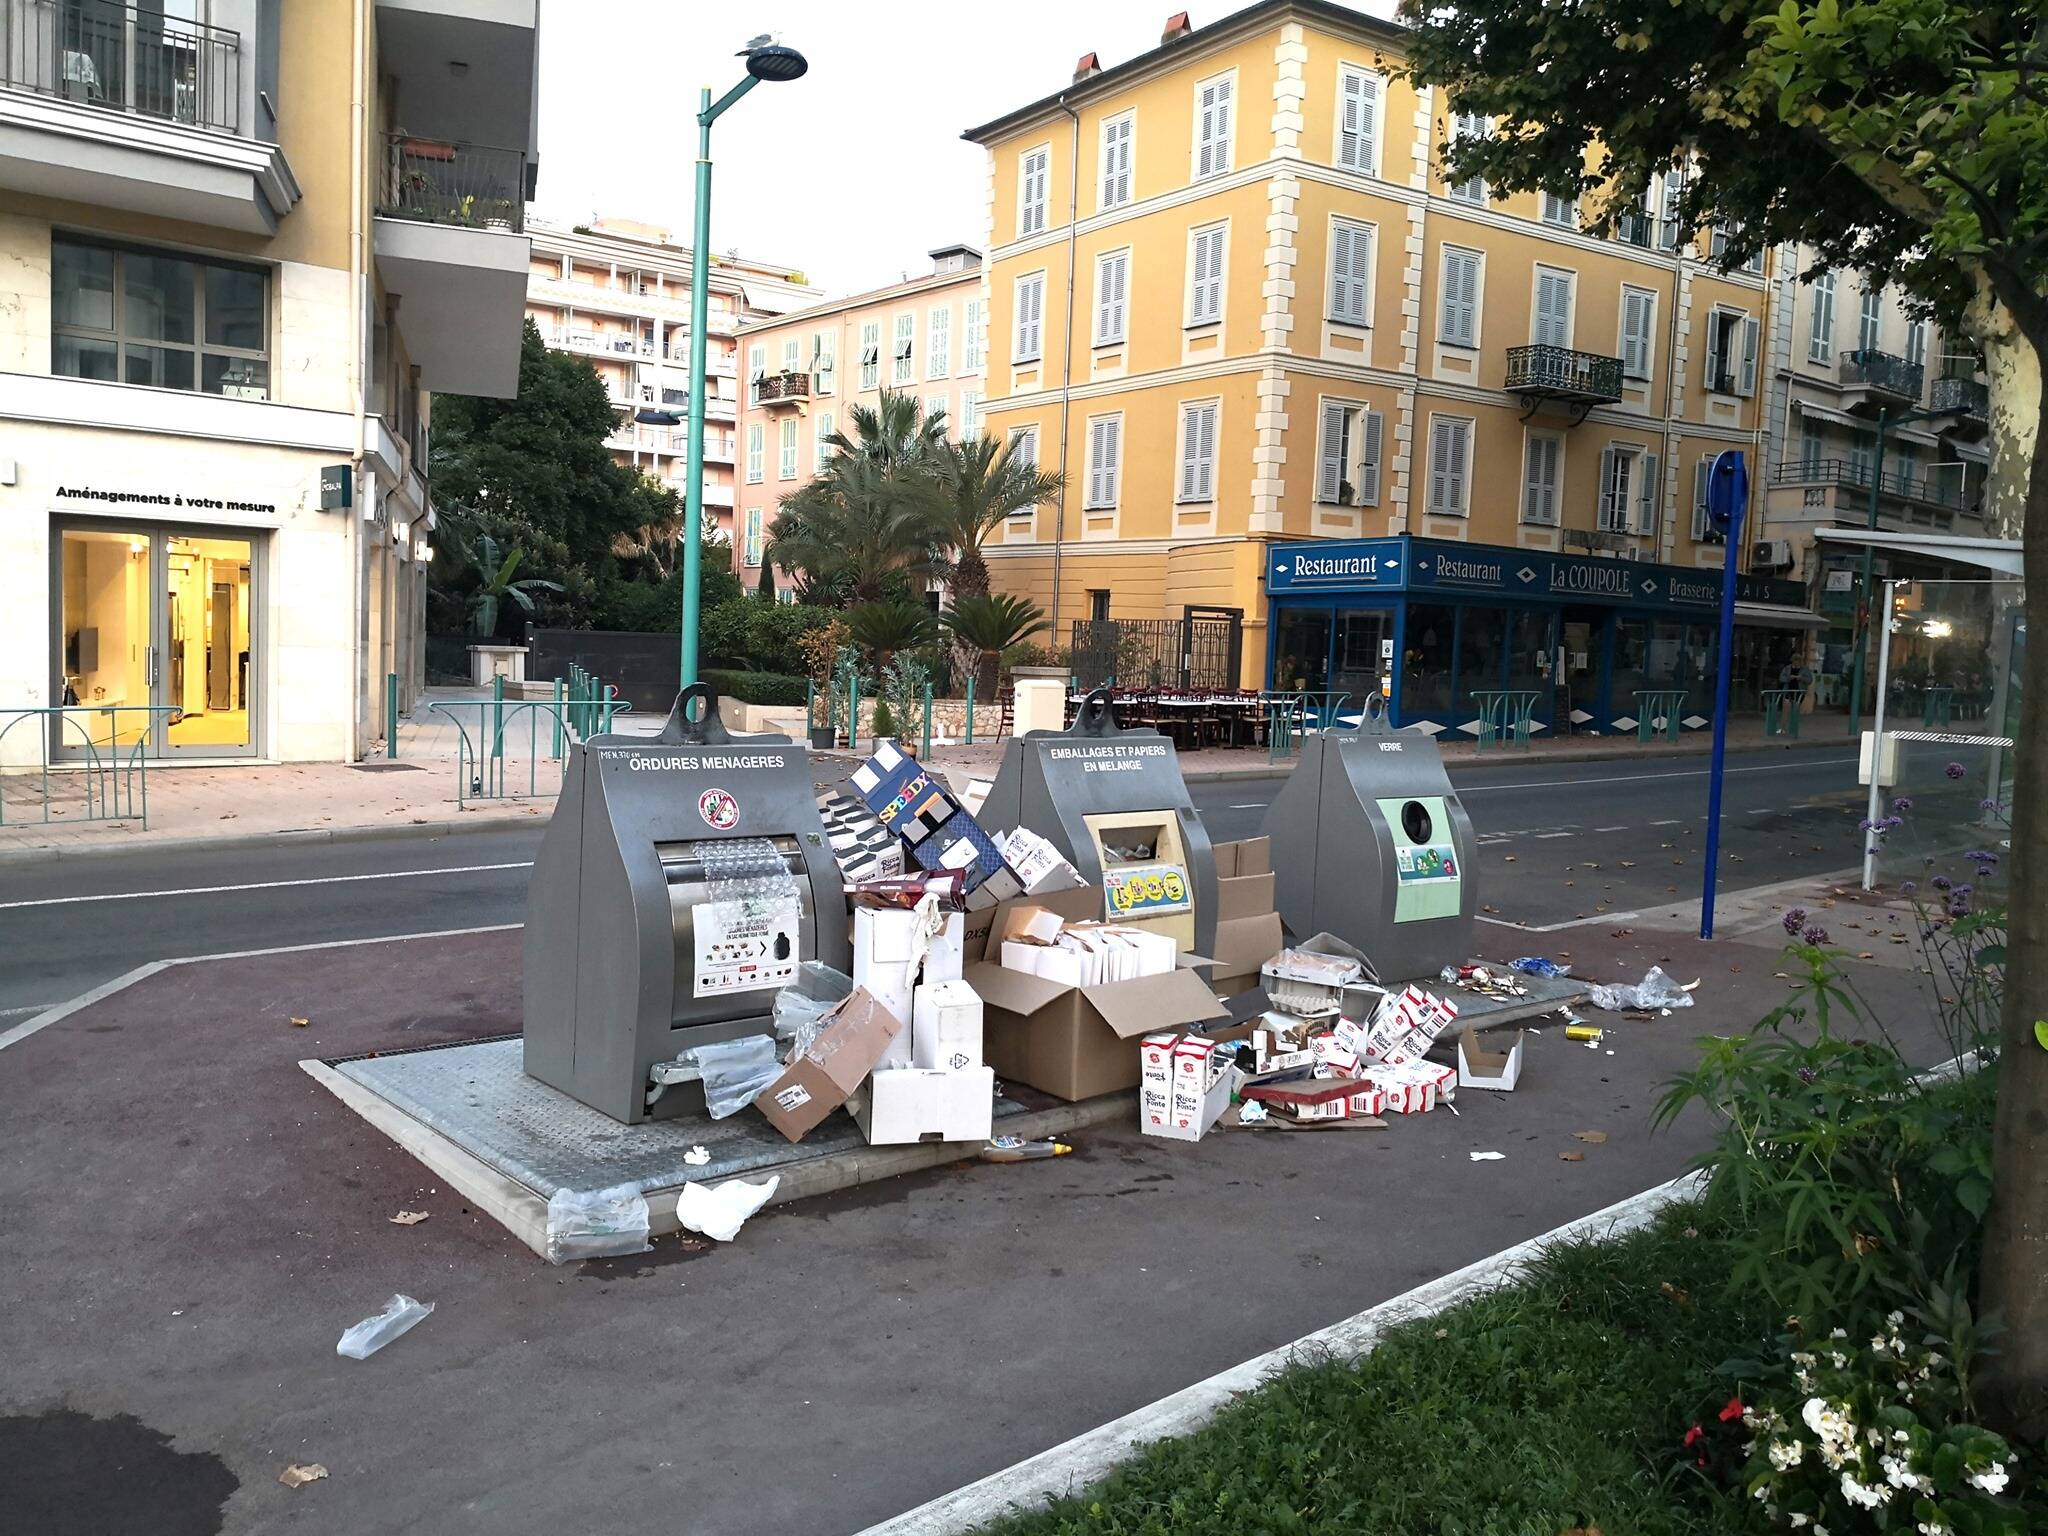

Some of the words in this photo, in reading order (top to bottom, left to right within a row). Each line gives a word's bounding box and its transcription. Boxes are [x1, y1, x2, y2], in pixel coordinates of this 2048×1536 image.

[56, 486, 170, 505] Aménagements
[174, 494, 182, 506] à
[186, 498, 223, 509] votre
[226, 501, 275, 513] mesure
[1295, 554, 1376, 576] Restaurant
[1437, 554, 1502, 581] Restaurant
[1551, 563, 1565, 587] La
[1569, 565, 1630, 593] COUPOLE
[1669, 577, 1715, 599] Brasserie
[1051, 747, 1114, 759] EMBALLAGES
[1115, 747, 1127, 757] ET
[1128, 746, 1166, 756] PAPIERS
[1378, 742, 1403, 752] VERRE
[629, 757, 699, 771] ORDURES
[702, 755, 784, 770] MENAGERES
[1083, 762, 1097, 772] EN
[1098, 760, 1143, 771] MELANGE
[879, 772, 930, 824] SPEEDY
[881, 856, 900, 867] Ricca
[1377, 1031, 1391, 1046] Ricca
[1407, 1037, 1422, 1052] Ricca
[1145, 1090, 1166, 1101] Ricca
[1146, 1098, 1166, 1108] Fonte
[1175, 1093, 1197, 1104] Ricca
[1176, 1101, 1197, 1111] Fonte
